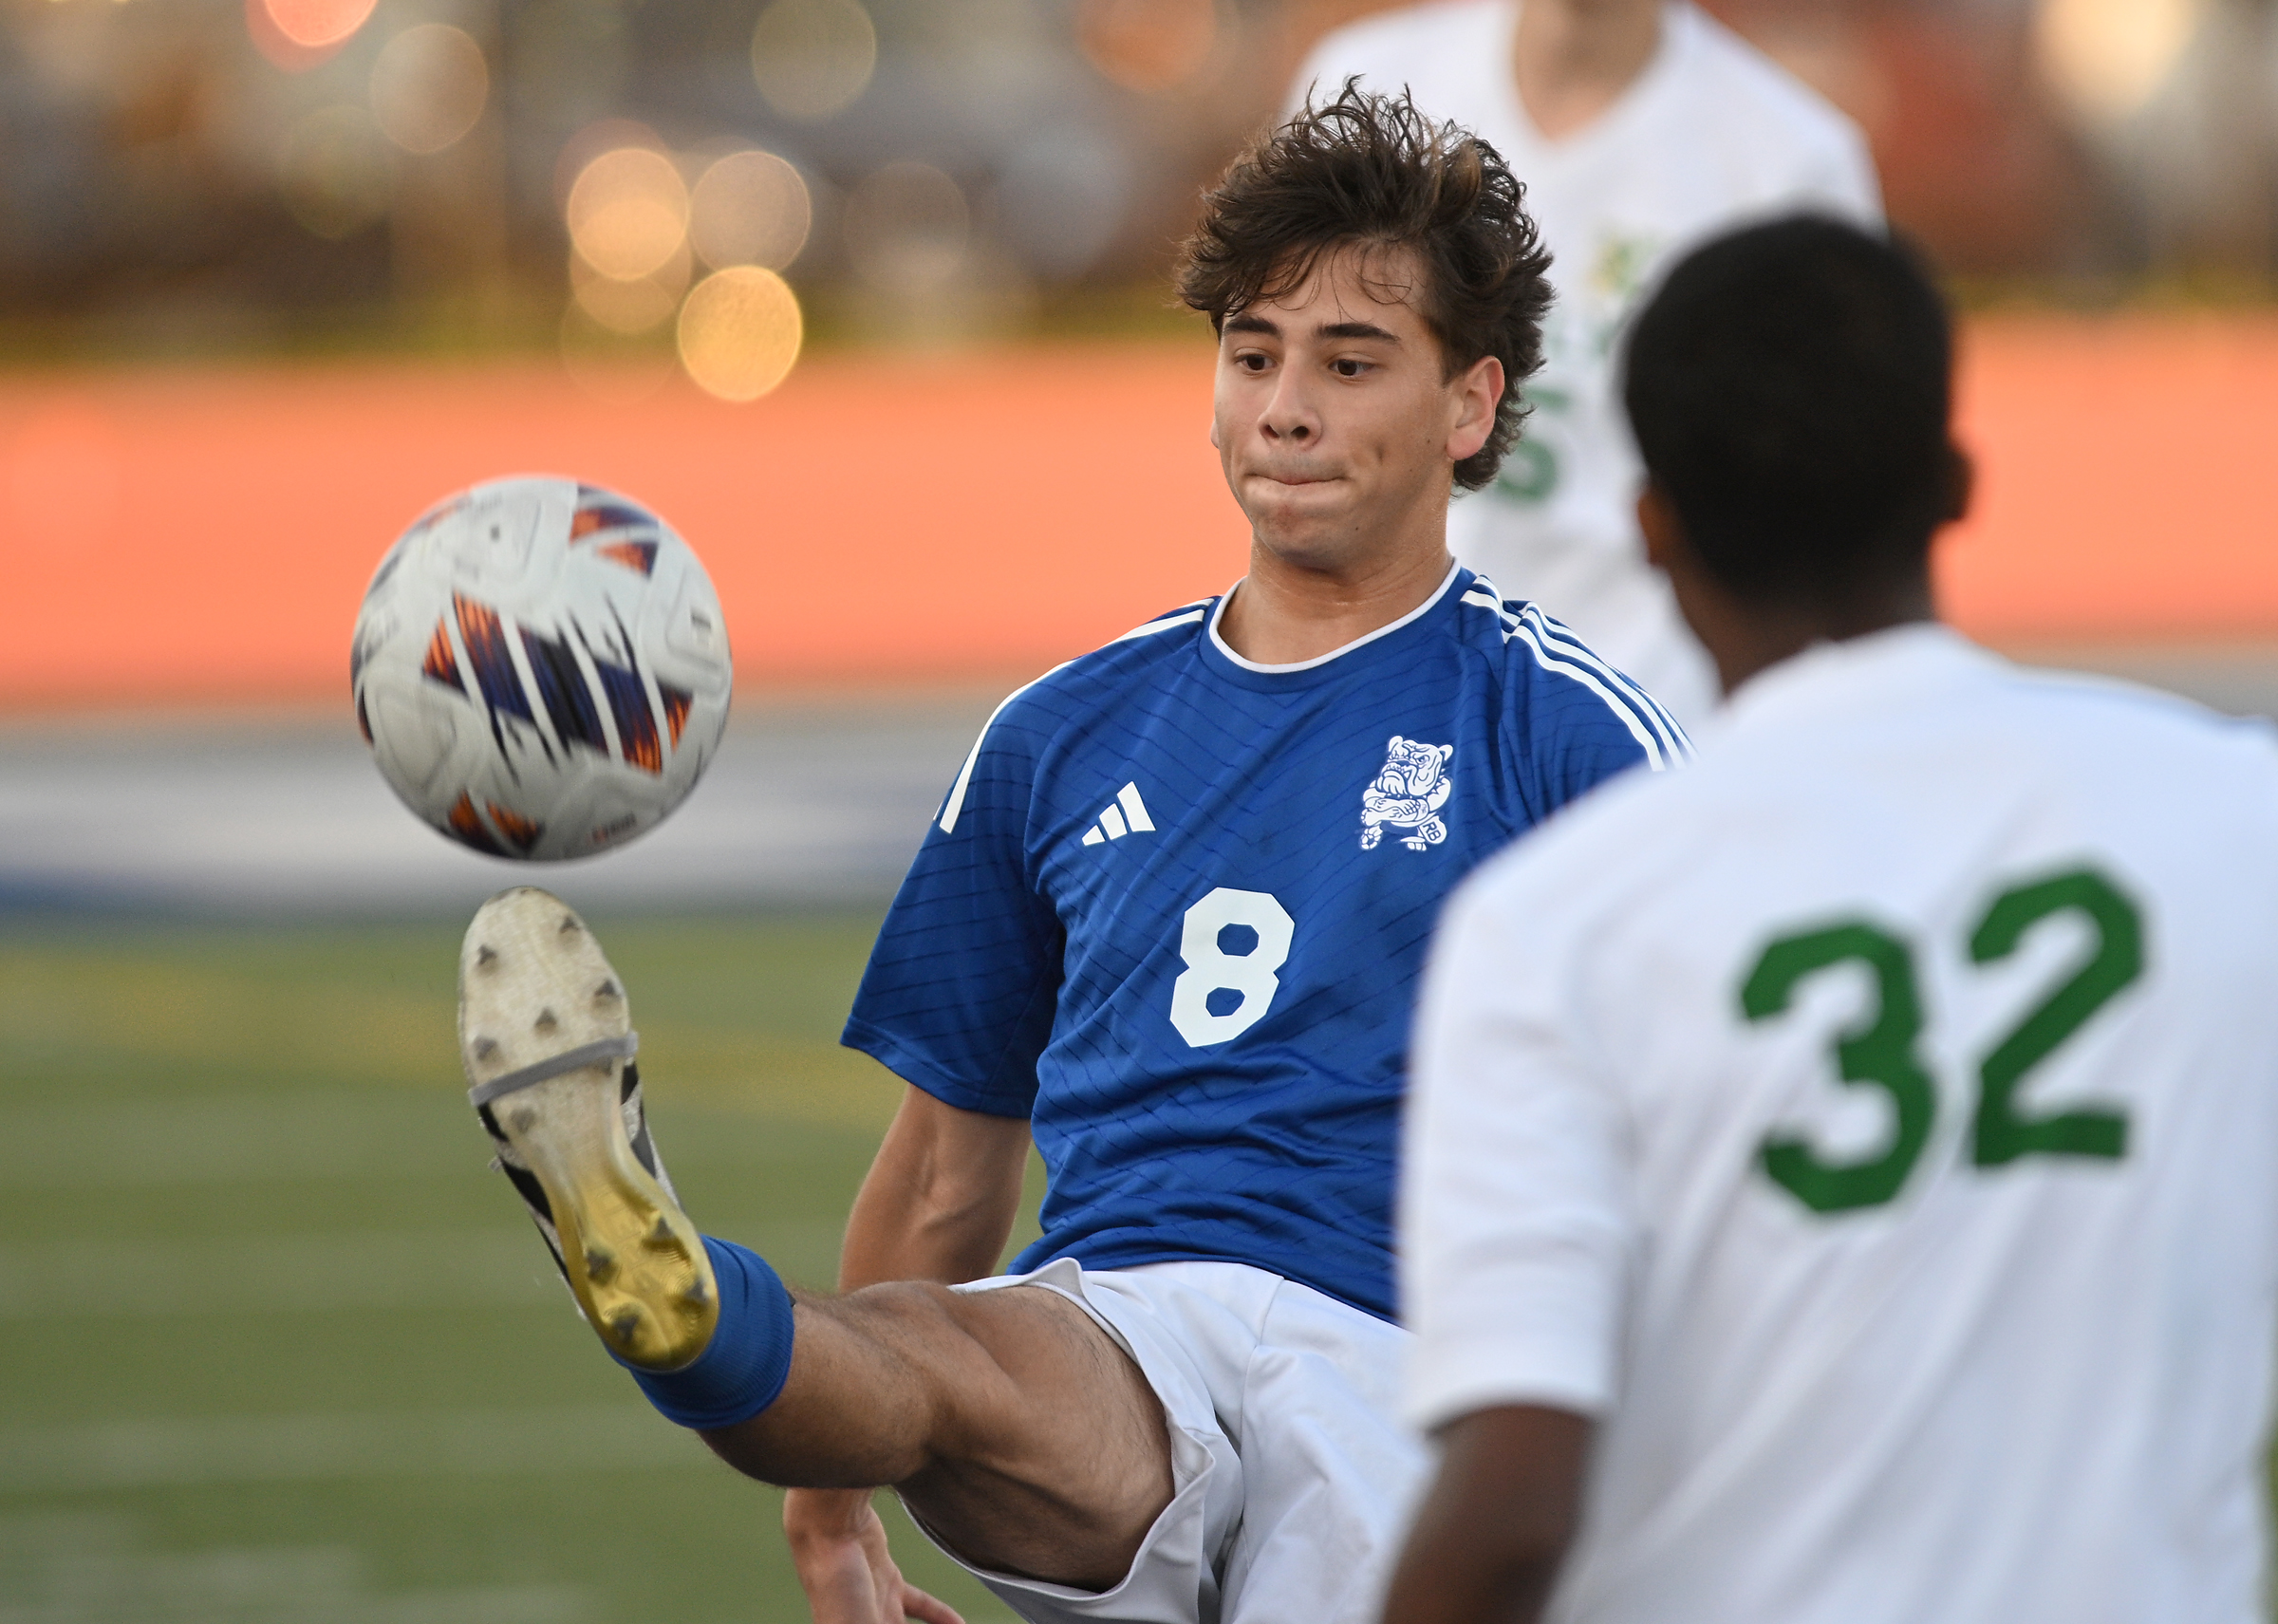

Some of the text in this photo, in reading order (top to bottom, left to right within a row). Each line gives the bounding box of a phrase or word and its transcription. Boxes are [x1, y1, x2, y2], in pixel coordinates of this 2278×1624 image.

[1422, 821, 1441, 841] RB
[1169, 887, 1295, 1048] 8
[1739, 868, 2145, 1214] 32
